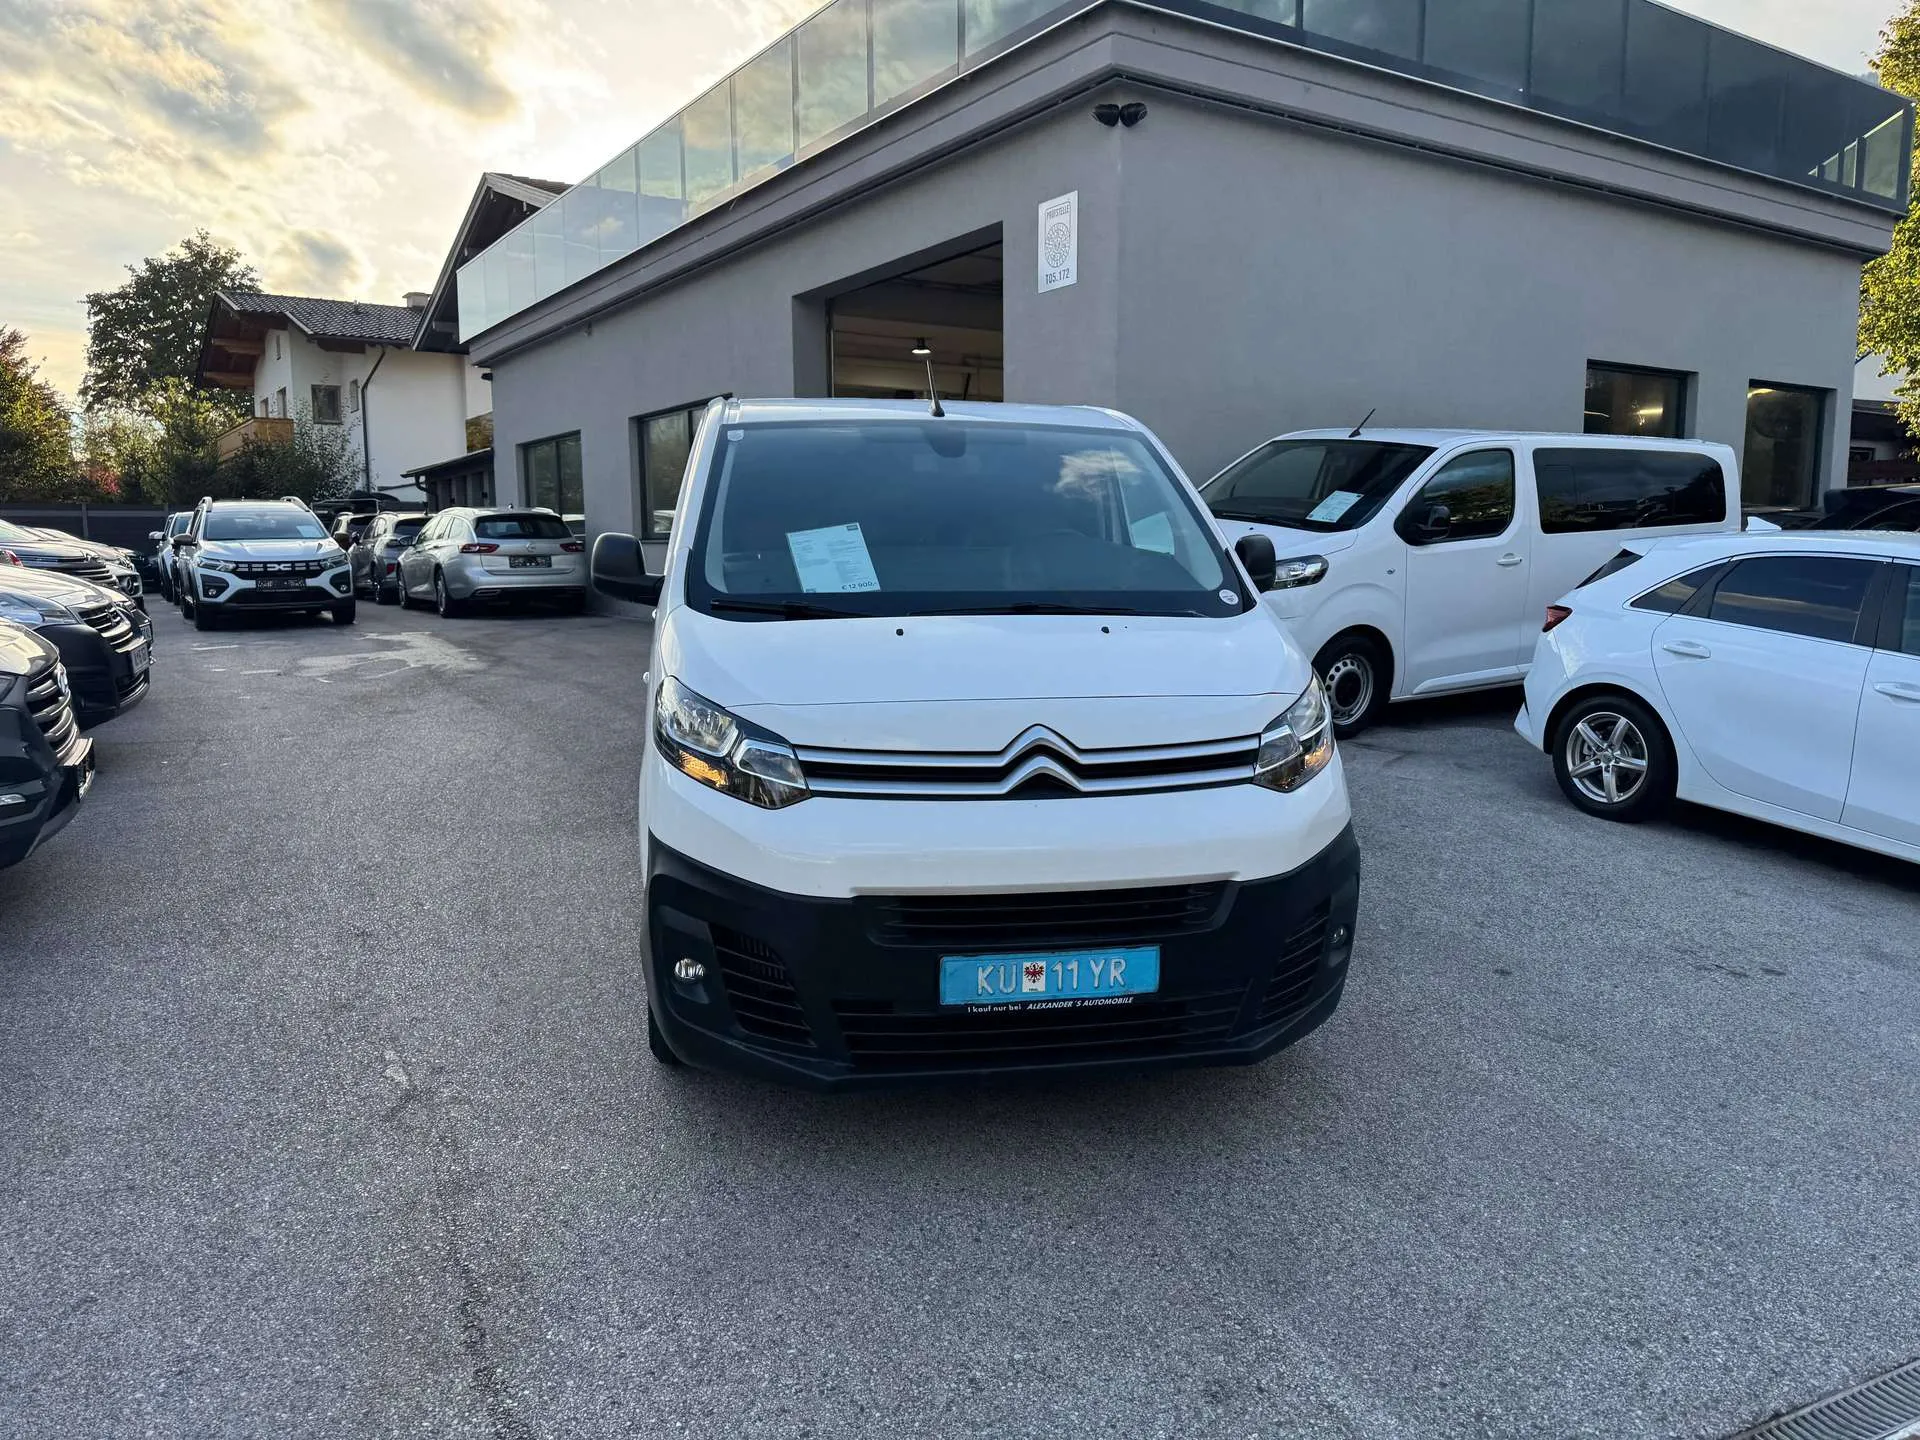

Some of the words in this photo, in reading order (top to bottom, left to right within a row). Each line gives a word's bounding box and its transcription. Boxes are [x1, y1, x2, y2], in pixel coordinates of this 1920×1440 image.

[977, 964, 1017, 995] KU
[1051, 960, 1078, 991] 11
[1089, 958, 1127, 988] YR
[972, 1004, 991, 1013] kauf
[1008, 1003, 1022, 1011] bei
[1082, 997, 1134, 1007] AUTOMOBILE
